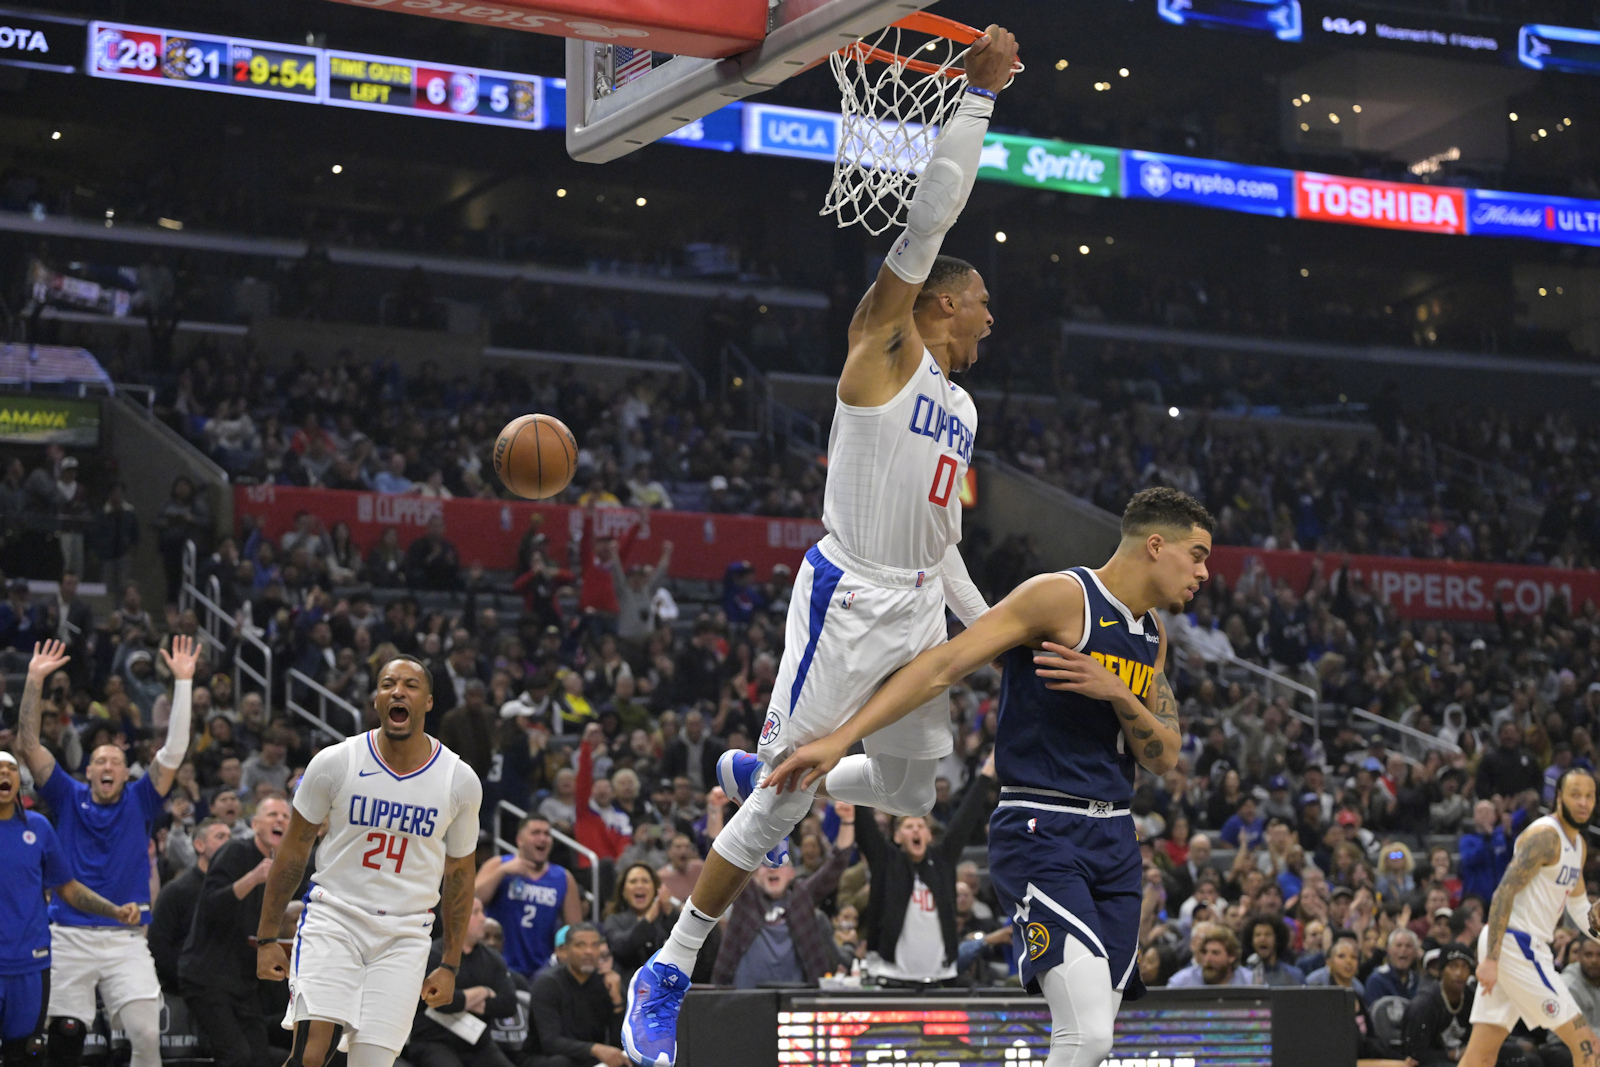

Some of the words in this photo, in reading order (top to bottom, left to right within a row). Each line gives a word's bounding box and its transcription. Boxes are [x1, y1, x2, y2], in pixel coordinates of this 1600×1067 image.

[118, 39, 157, 71] 28
[184, 50, 220, 78] 31
[329, 56, 368, 78] TIME
[368, 62, 412, 84] OUTS
[234, 60, 249, 82] 2
[249, 55, 317, 90] 9:54
[349, 82, 391, 104] LEFT
[426, 79, 446, 105] 6
[490, 85, 509, 112] 5
[767, 119, 829, 148] UCLA
[1022, 145, 1105, 183] Sprite
[1172, 169, 1279, 201] crypto.com
[1302, 180, 1459, 226] TOSHIBA
[1557, 209, 1600, 232] ULT
[928, 454, 958, 508] 0
[349, 794, 438, 838] CLIPPERS
[362, 832, 409, 874] 24
[521, 904, 538, 928] 2
